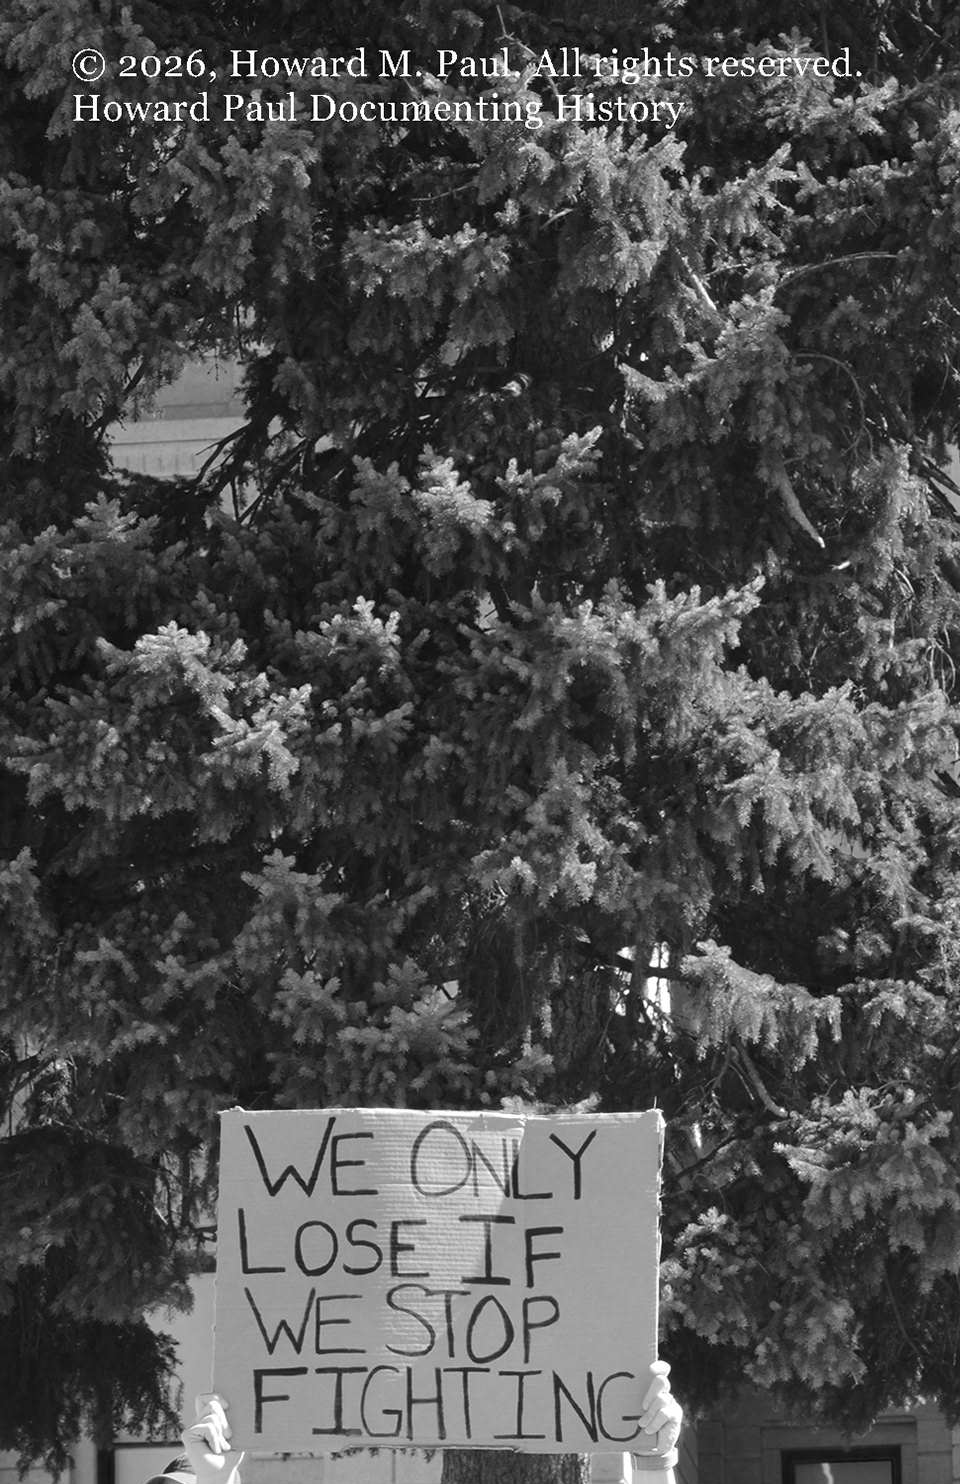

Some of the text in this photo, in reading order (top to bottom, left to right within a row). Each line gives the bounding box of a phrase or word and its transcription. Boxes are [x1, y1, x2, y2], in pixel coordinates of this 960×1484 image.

[243, 1117, 598, 1200] WE ONLY
[237, 1208, 565, 1288] LOSE IF
[244, 1283, 561, 1364] WE STOP
[252, 1365, 642, 1443] FIGHTING
